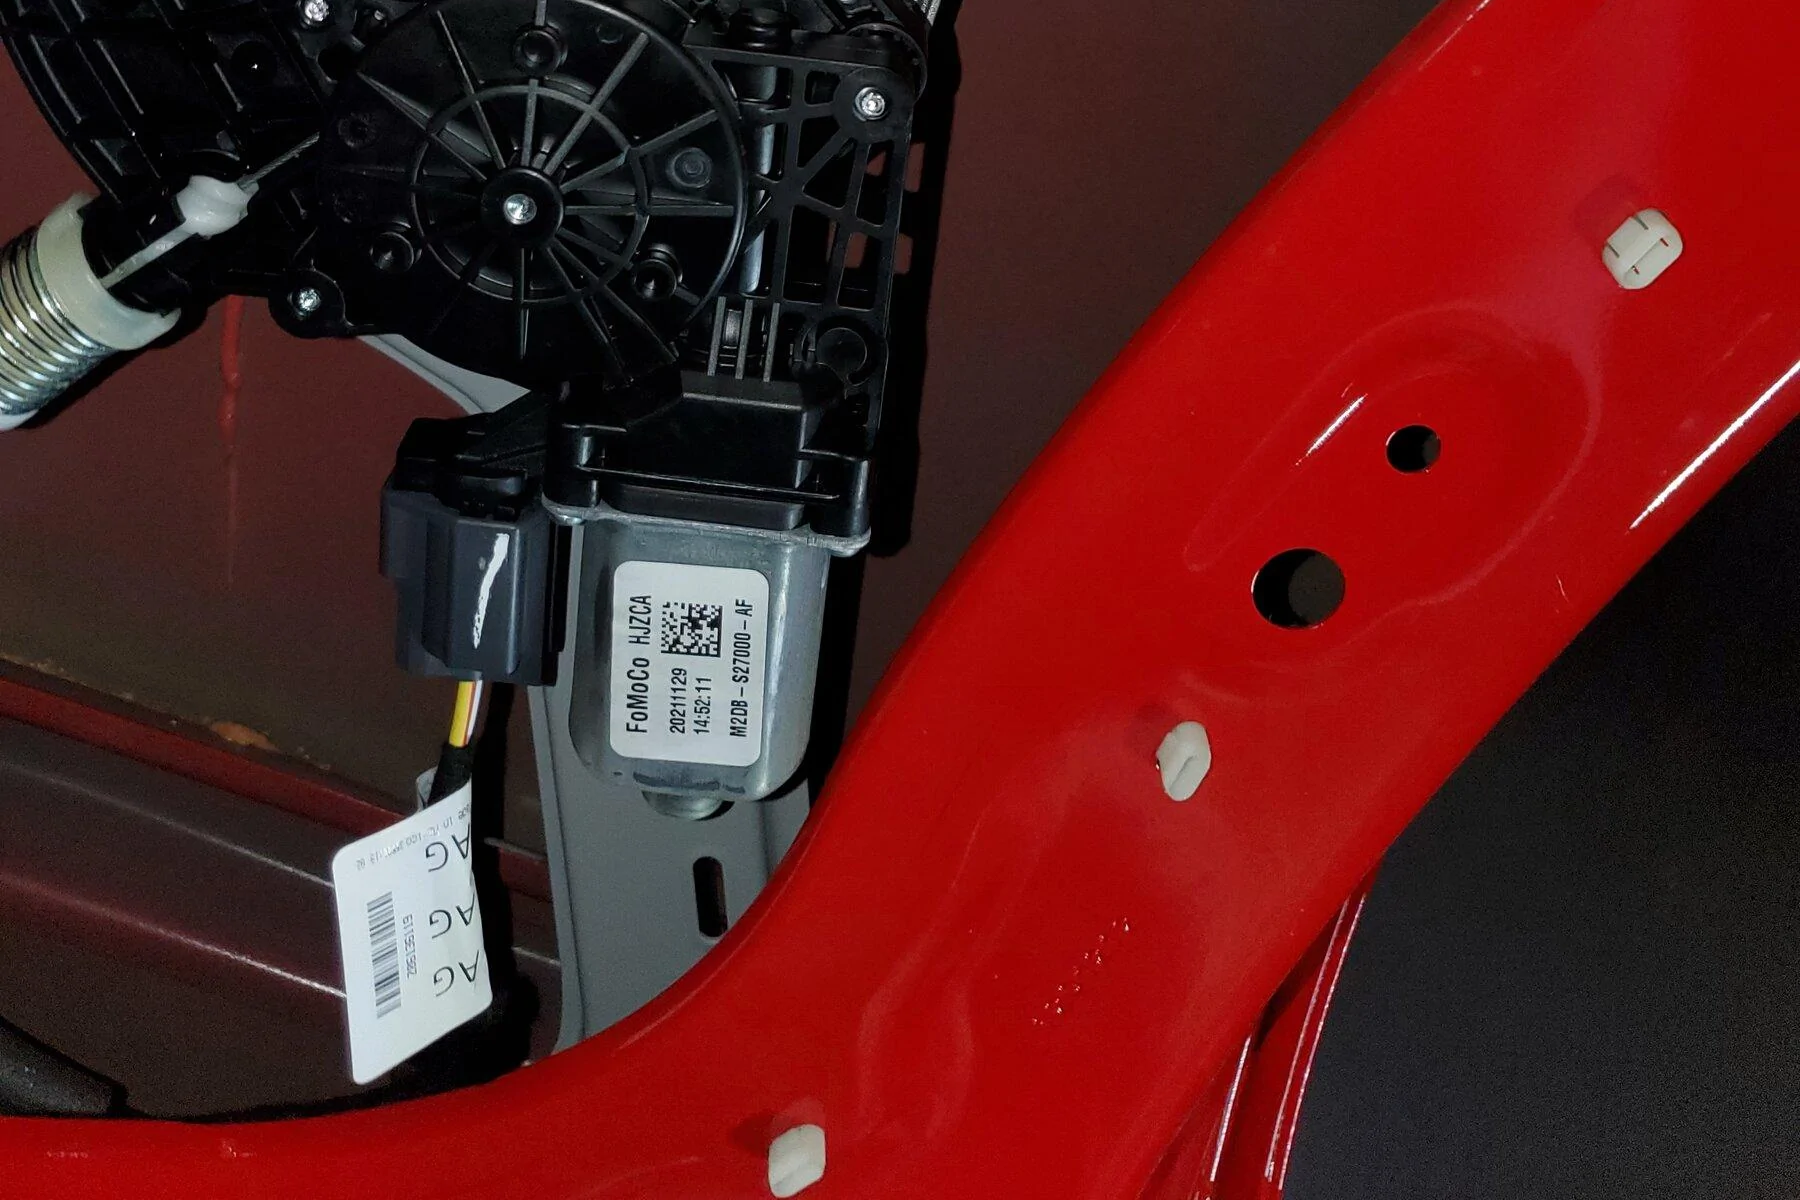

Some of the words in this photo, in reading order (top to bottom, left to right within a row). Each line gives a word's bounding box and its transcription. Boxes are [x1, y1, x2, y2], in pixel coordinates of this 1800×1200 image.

[628, 595, 651, 645] HJZCA
[626, 657, 650, 734] FoMoCo
[669, 667, 688, 735] 20211129
[693, 676, 712, 735] 14:52:11
[425, 822, 471, 873] AG
[428, 892, 476, 939] AG
[432, 948, 480, 998] AG
